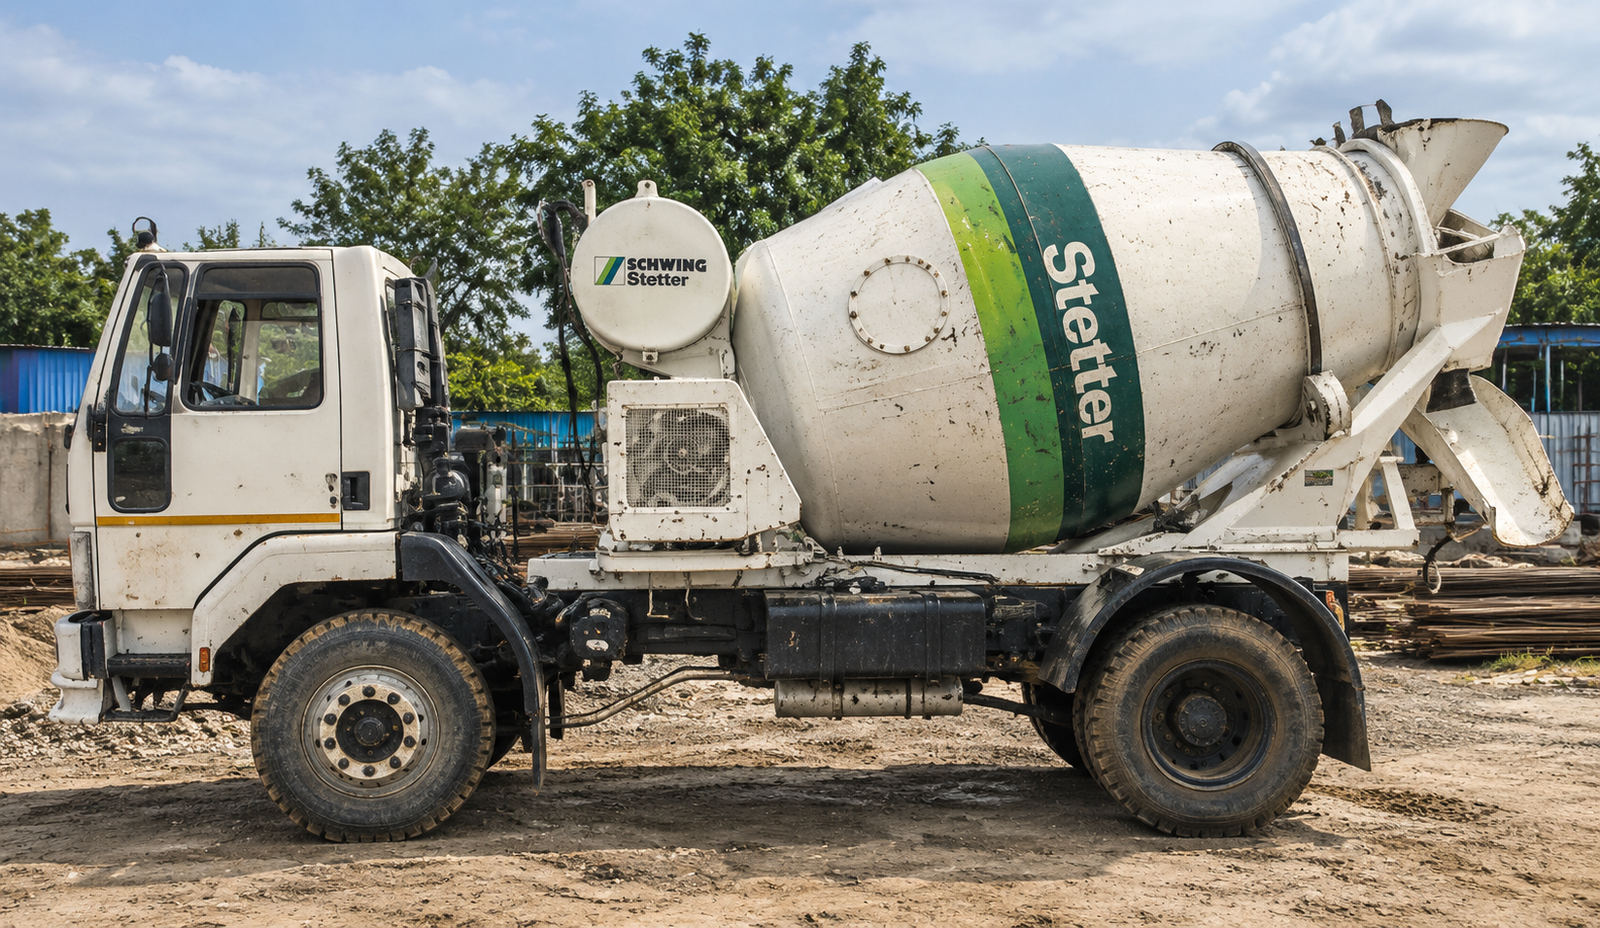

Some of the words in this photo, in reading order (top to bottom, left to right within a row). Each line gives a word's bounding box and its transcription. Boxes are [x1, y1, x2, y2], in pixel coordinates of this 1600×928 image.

[627, 258, 707, 272] SCHWING
[627, 272, 689, 286] Stetter
[1043, 241, 1118, 443] Stetter
